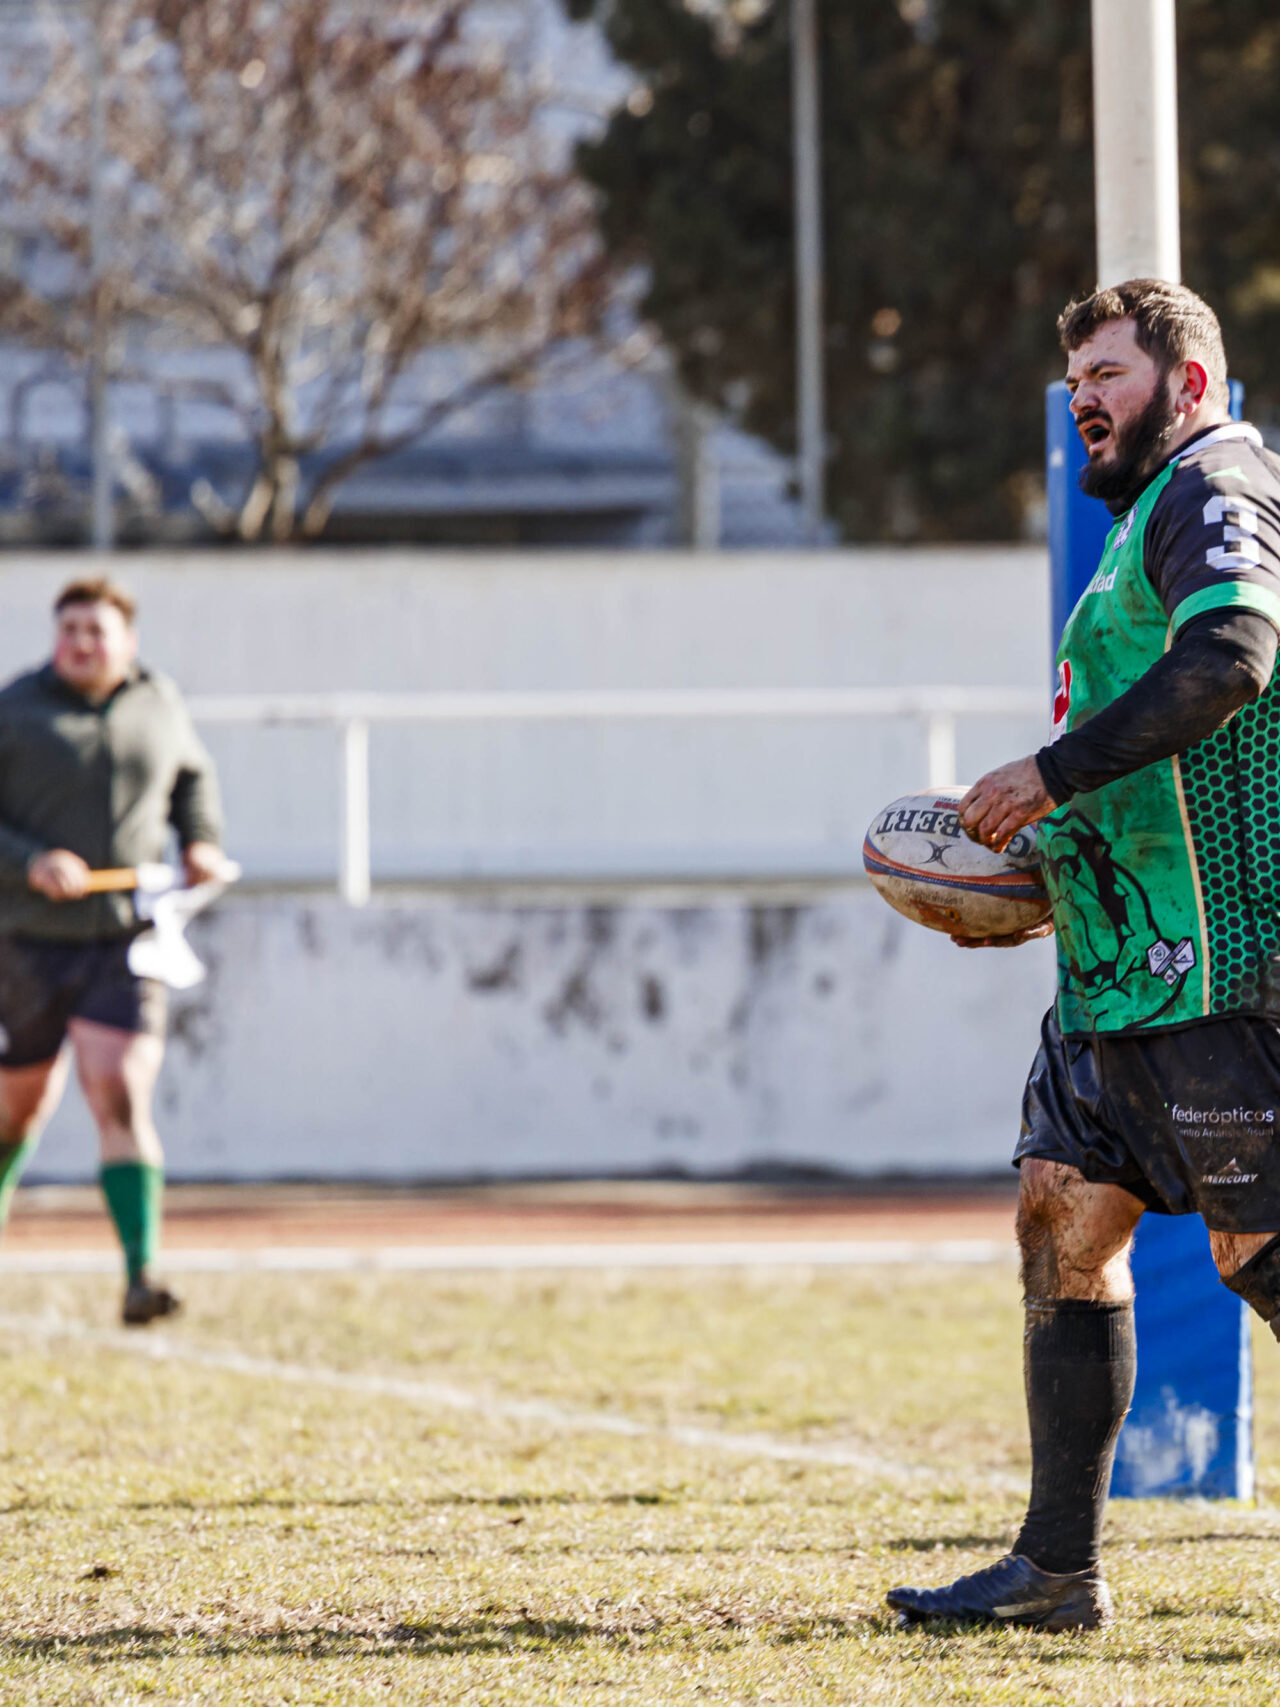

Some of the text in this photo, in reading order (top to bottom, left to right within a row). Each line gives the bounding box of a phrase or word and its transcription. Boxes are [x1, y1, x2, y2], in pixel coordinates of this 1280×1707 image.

[1203, 496, 1260, 570] 3
[876, 809, 1031, 859] GBERT
[1172, 1104, 1274, 1124] federópticos
